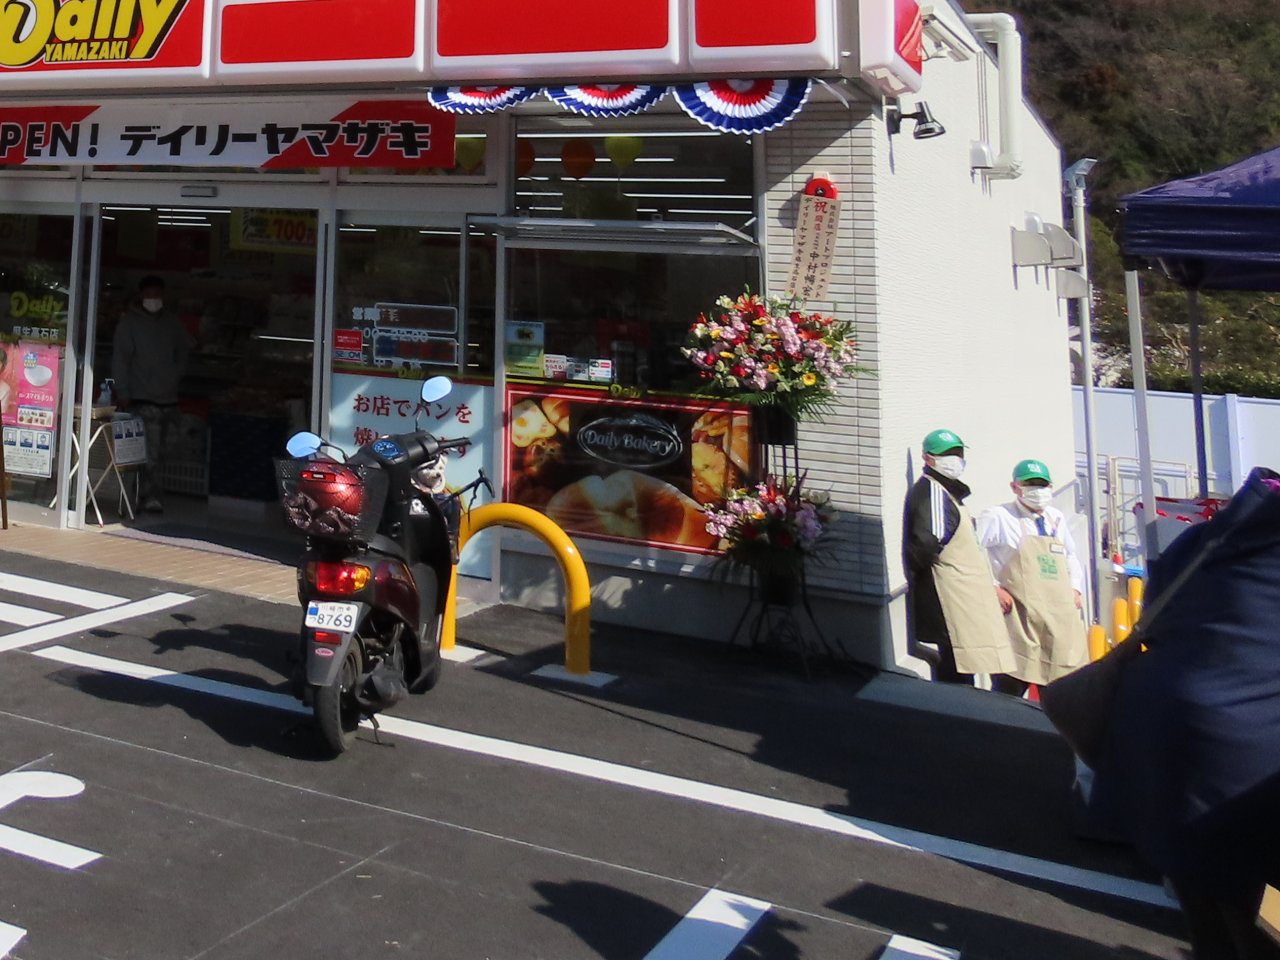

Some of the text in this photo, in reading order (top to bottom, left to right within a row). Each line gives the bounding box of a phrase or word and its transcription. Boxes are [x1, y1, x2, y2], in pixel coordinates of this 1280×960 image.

[44, 40, 128, 62] YAMAZAKI
[119, 120, 431, 158] デイリーヤマザキ
[584, 430, 673, 456] Daily Bakery
[317, 613, 353, 628] 8769
